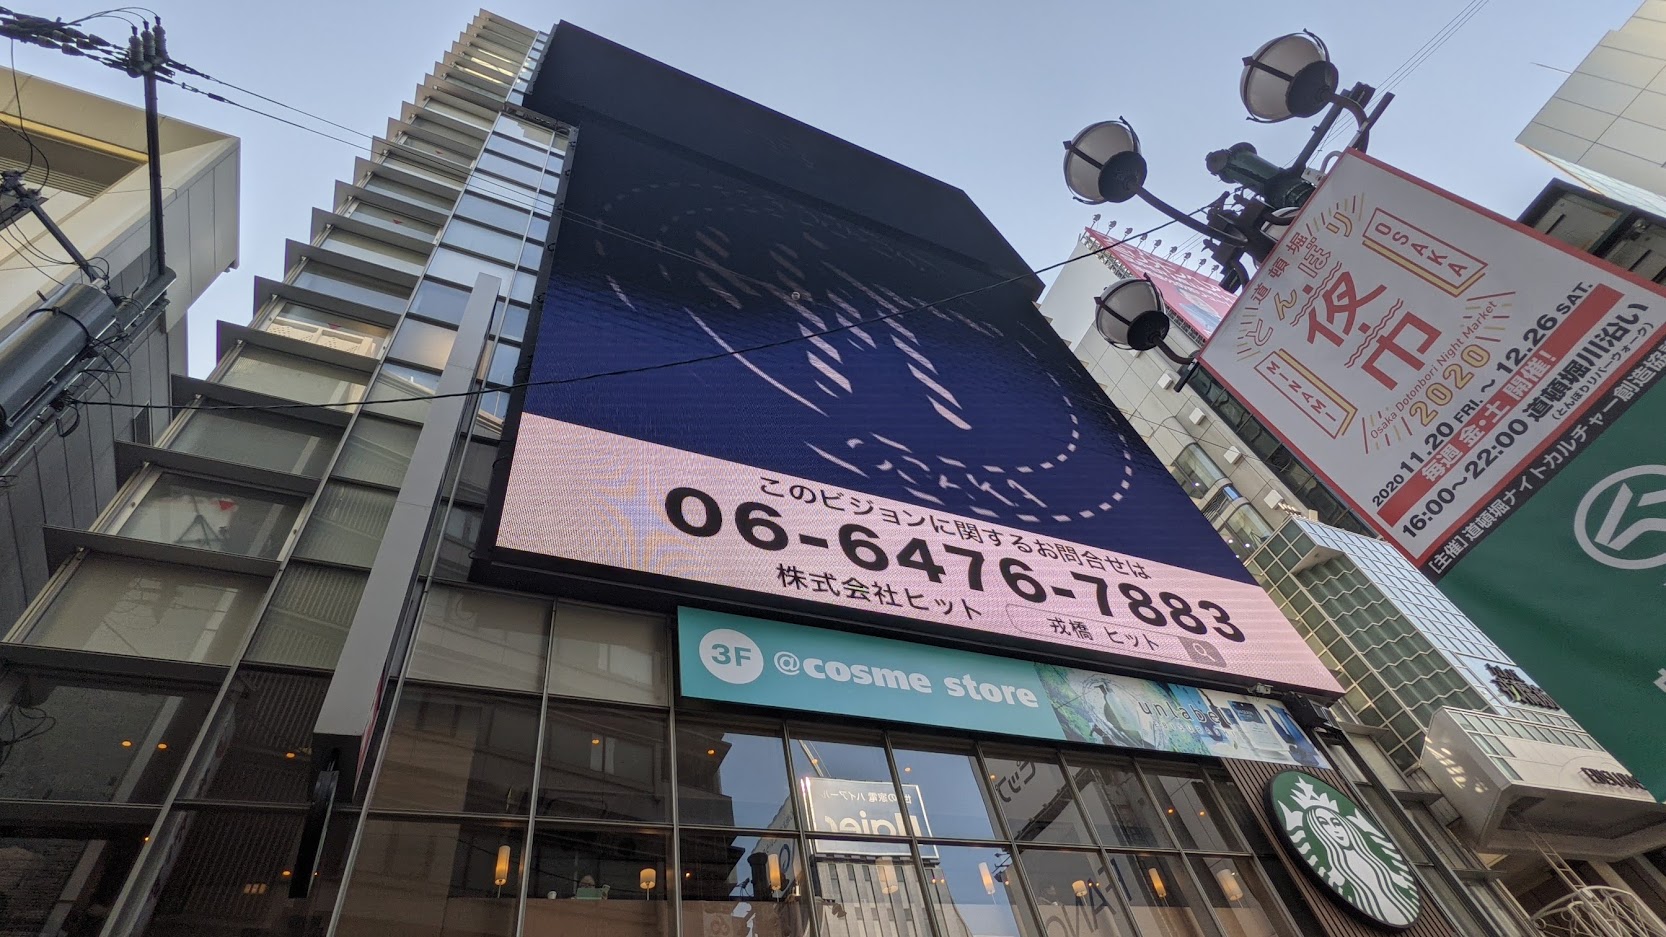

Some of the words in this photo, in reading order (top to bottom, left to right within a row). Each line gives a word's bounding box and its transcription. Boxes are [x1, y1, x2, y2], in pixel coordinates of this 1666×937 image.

[1246, 211, 1353, 346] とんぼり
[1251, 232, 1308, 305] 道頓堀
[1374, 222, 1468, 277] OSAKA
[1266, 360, 1336, 422] MINAMI
[1370, 412, 1398, 439] Osaka
[1395, 364, 1439, 412] Dotonbori
[1436, 338, 1465, 367] Night
[1462, 301, 1498, 339] Market
[1372, 474, 1405, 507] 2020
[1400, 422, 1454, 473] 11.20
[1453, 399, 1483, 424] FRI.
[1496, 314, 1558, 374] 12.26
[1556, 282, 1593, 315] SAT.
[1409, 344, 1491, 427] 2020
[1522, 303, 1649, 422] 道頓堀川沿い
[1422, 443, 1463, 482] 毎週
[760, 476, 1152, 580] このビジョンに関するお問合せは
[665, 487, 1245, 643] 06-6476-7883
[776, 563, 982, 621] 株式会社ヒット
[1046, 616, 1094, 641] 戎橋
[1103, 626, 1159, 651] ヒット
[711, 643, 752, 667] 3F
[773, 651, 933, 694] @cosme
[943, 673, 1039, 708] store
[1138, 701, 1232, 726] unlabel
